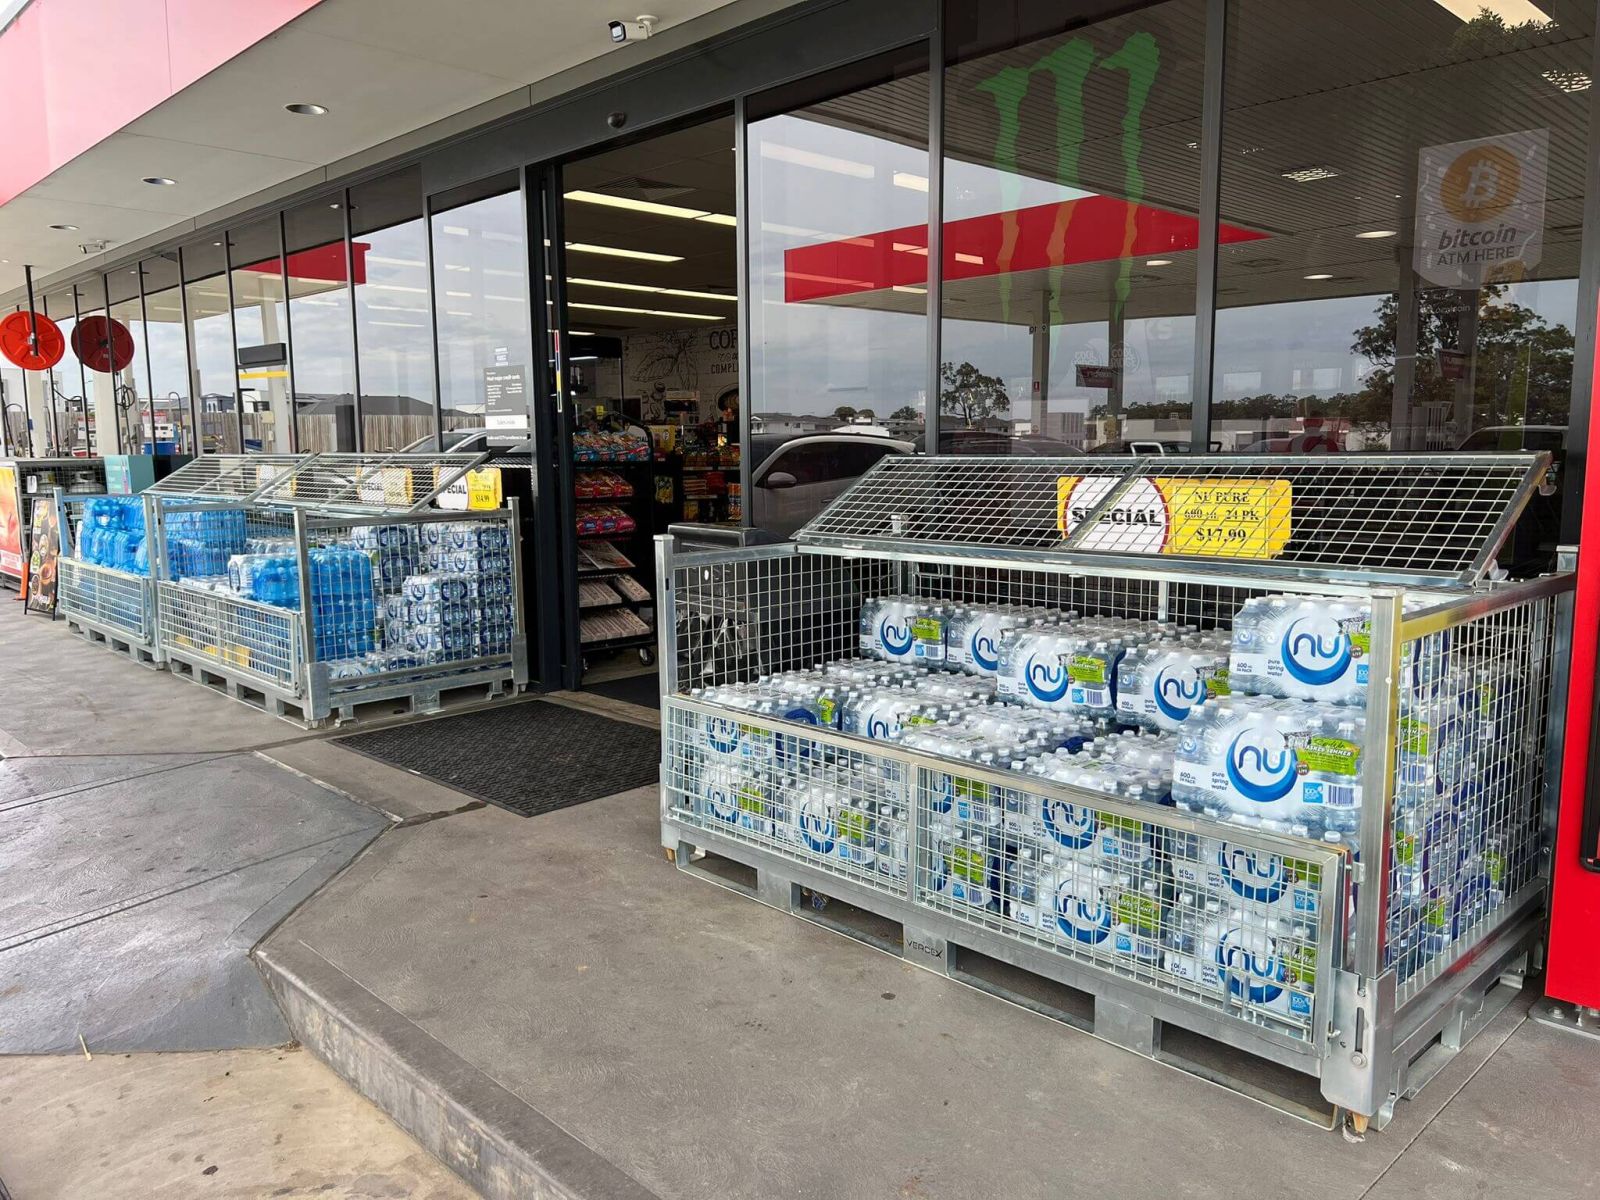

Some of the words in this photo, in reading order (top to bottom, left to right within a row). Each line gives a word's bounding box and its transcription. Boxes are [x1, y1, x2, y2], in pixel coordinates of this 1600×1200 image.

[1438, 223, 1517, 250] bitcoin
[1436, 251, 1470, 266] ATM
[1474, 245, 1515, 262] HERE
[1215, 491, 1250, 503] PURE
[1226, 509, 1239, 520] 24
[1242, 510, 1260, 521] PK
[1195, 527, 1247, 543] $17.99
[886, 624, 908, 641] nu
[1293, 633, 1340, 658] nu
[1033, 664, 1061, 684] nu
[1164, 678, 1199, 700] nu
[1239, 745, 1288, 774] nu
[1052, 801, 1088, 826] nu
[1232, 849, 1275, 879] nu
[1062, 894, 1102, 923] nu
[1227, 945, 1275, 978] nu
